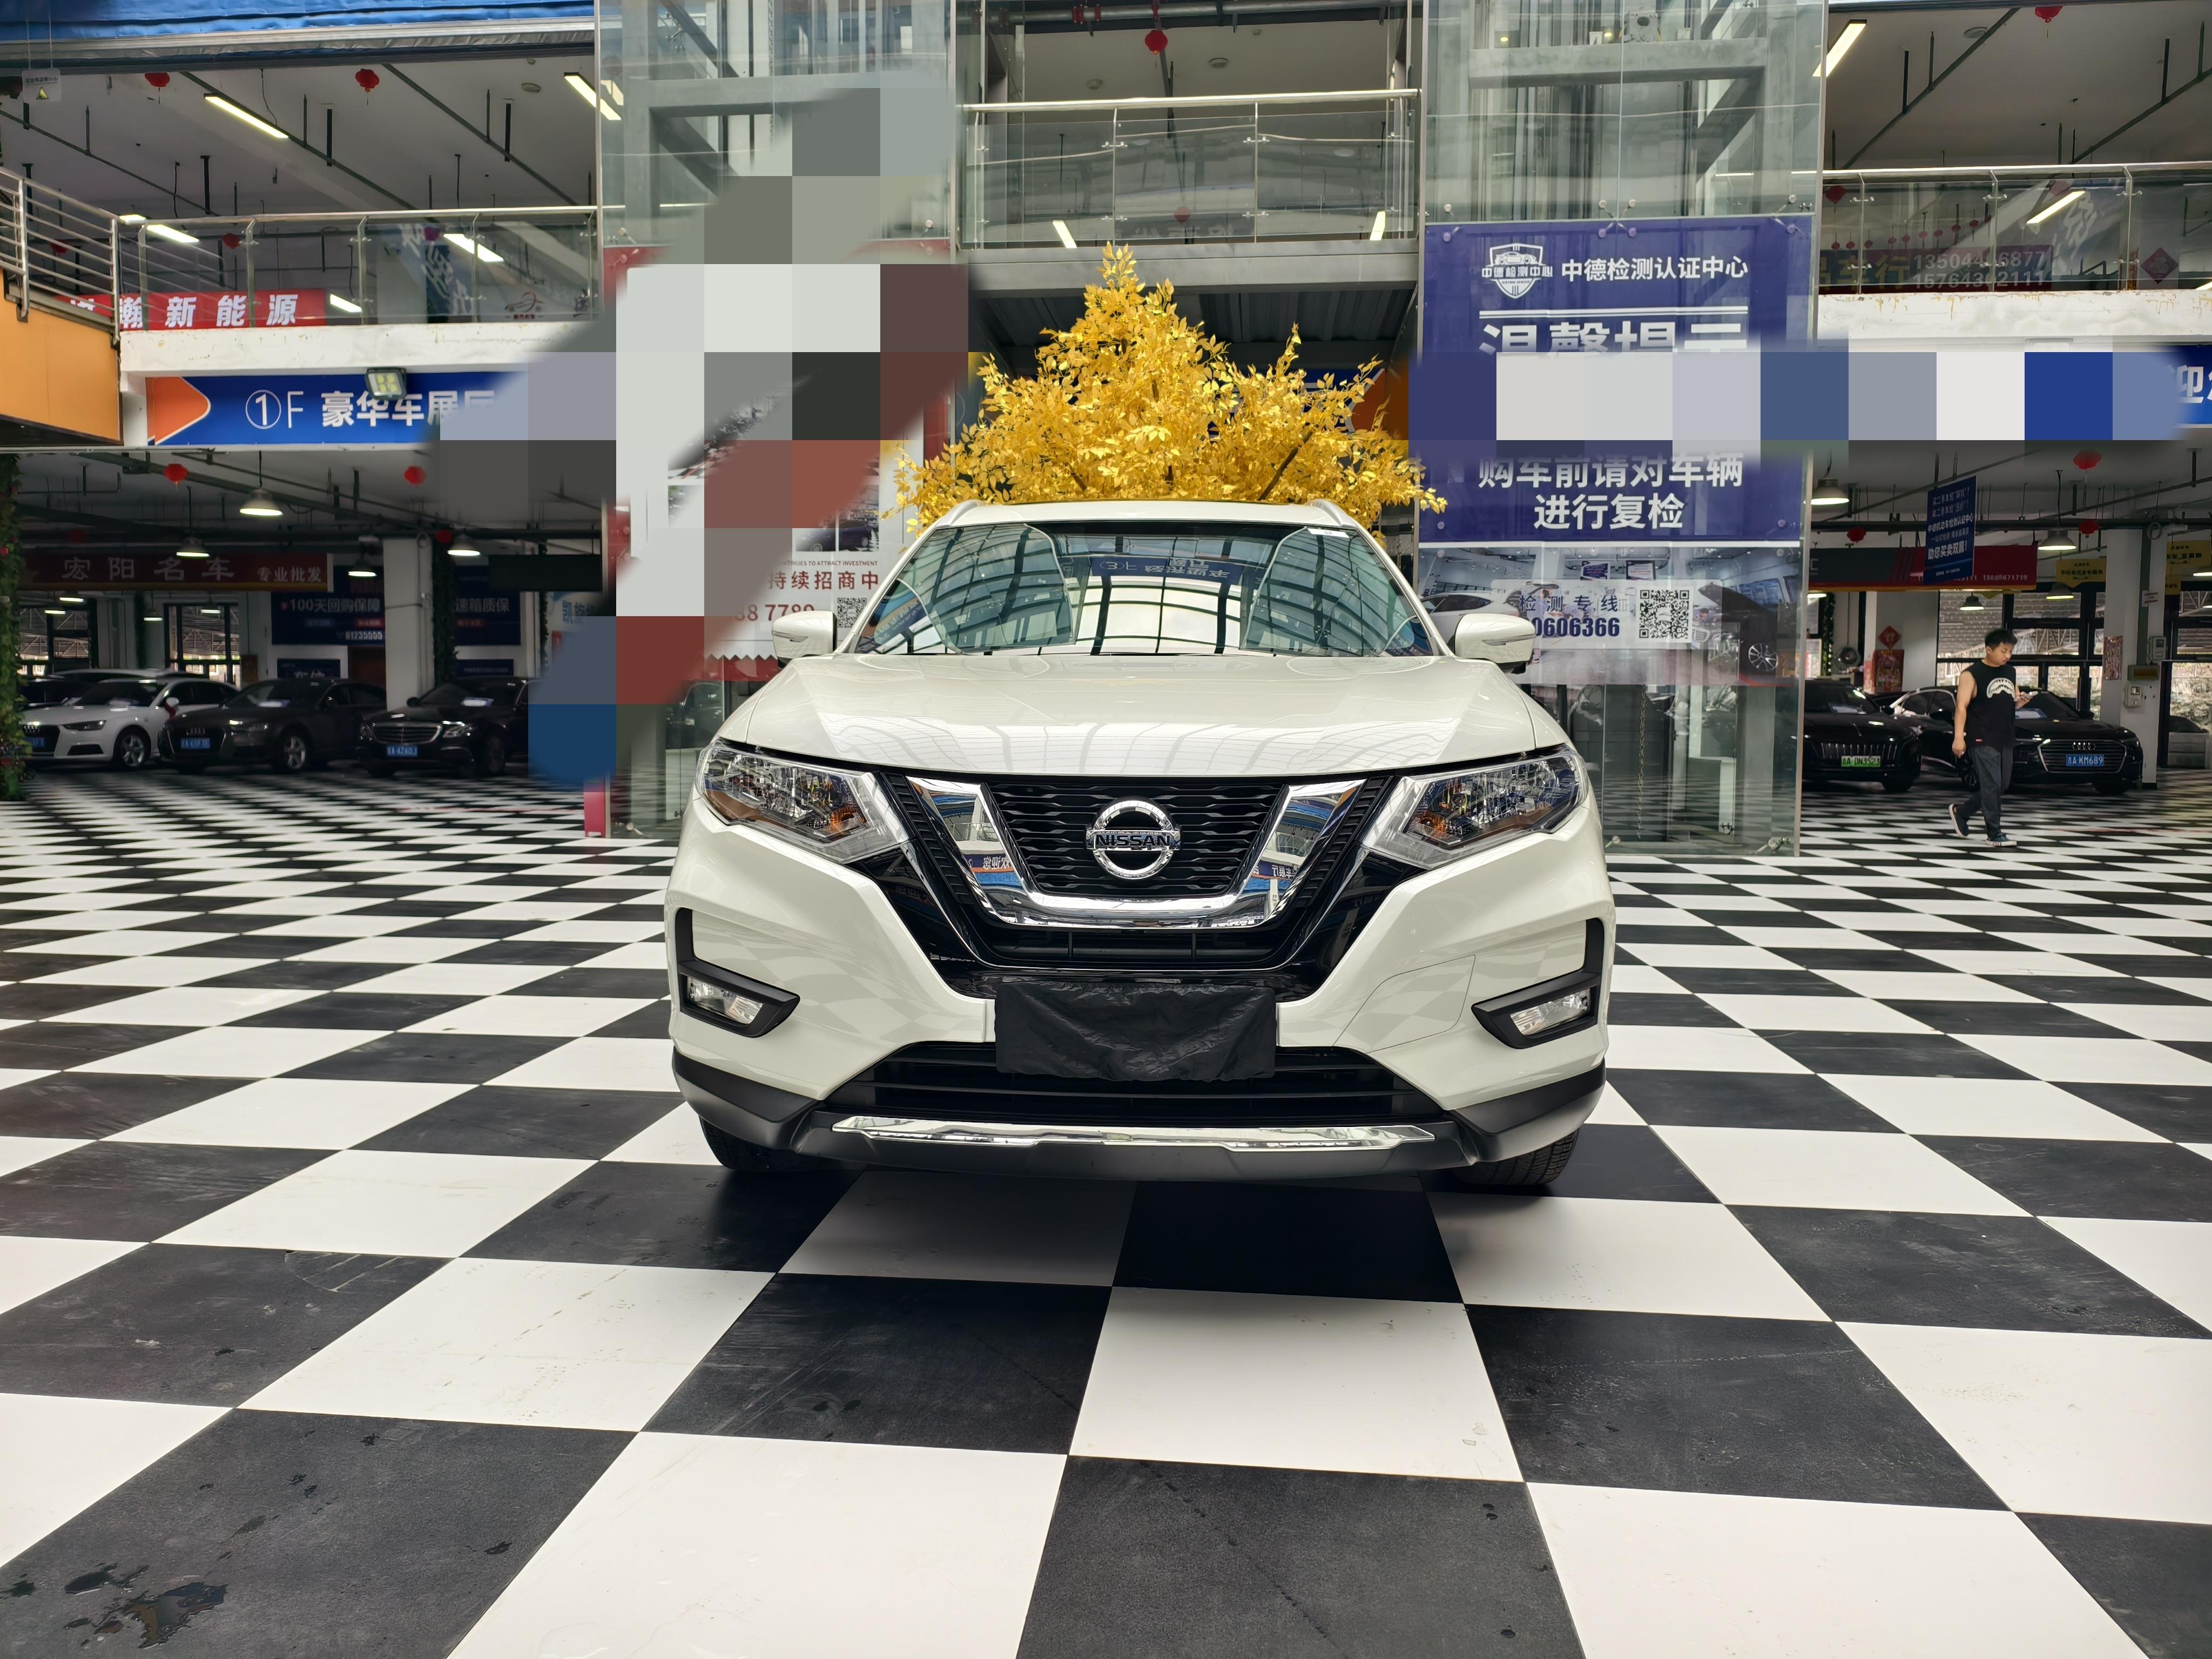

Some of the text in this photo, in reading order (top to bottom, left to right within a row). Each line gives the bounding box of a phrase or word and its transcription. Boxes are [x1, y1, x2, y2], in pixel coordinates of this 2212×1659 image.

[1561, 255, 1748, 282] 中德检测认证中心
[1914, 251, 2046, 269] 1350446877
[1478, 451, 1744, 488] 购车前请对车辆
[1533, 493, 1685, 530] 进行复检
[1519, 595, 1618, 612] 检测专线
[1096, 834, 1171, 846] NISSAN
